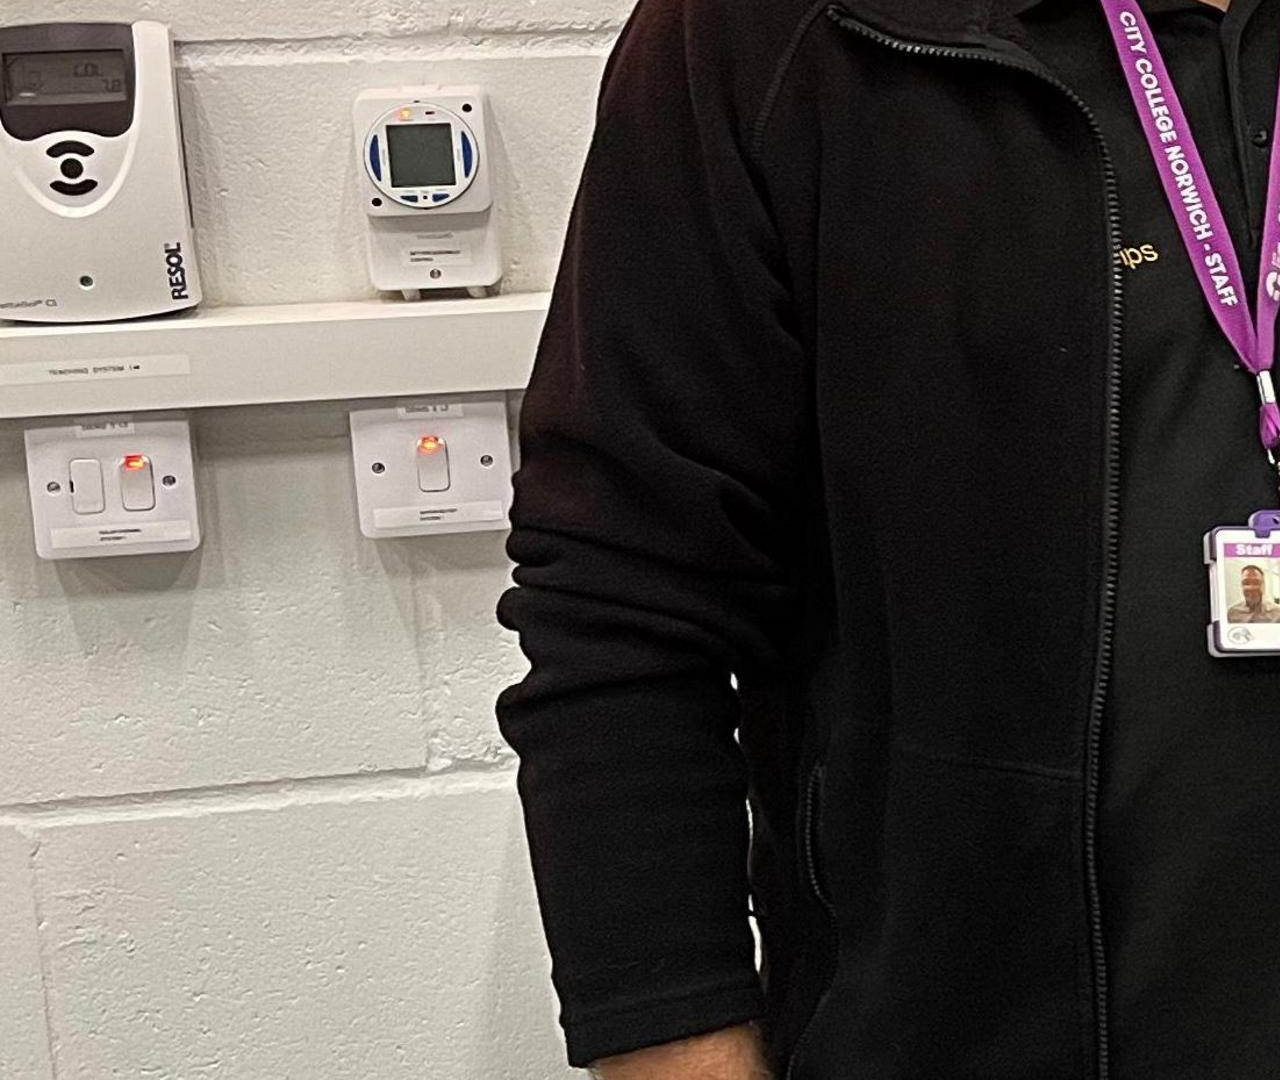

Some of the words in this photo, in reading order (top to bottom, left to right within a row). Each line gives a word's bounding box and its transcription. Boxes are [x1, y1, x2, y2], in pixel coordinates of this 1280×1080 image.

[1119, 11, 1148, 54] CITY
[1135, 58, 1178, 144] COLLEGE
[1164, 145, 1213, 241] NORWICH
[1205, 252, 1239, 307] STAFF
[1235, 543, 1274, 556] Staff
